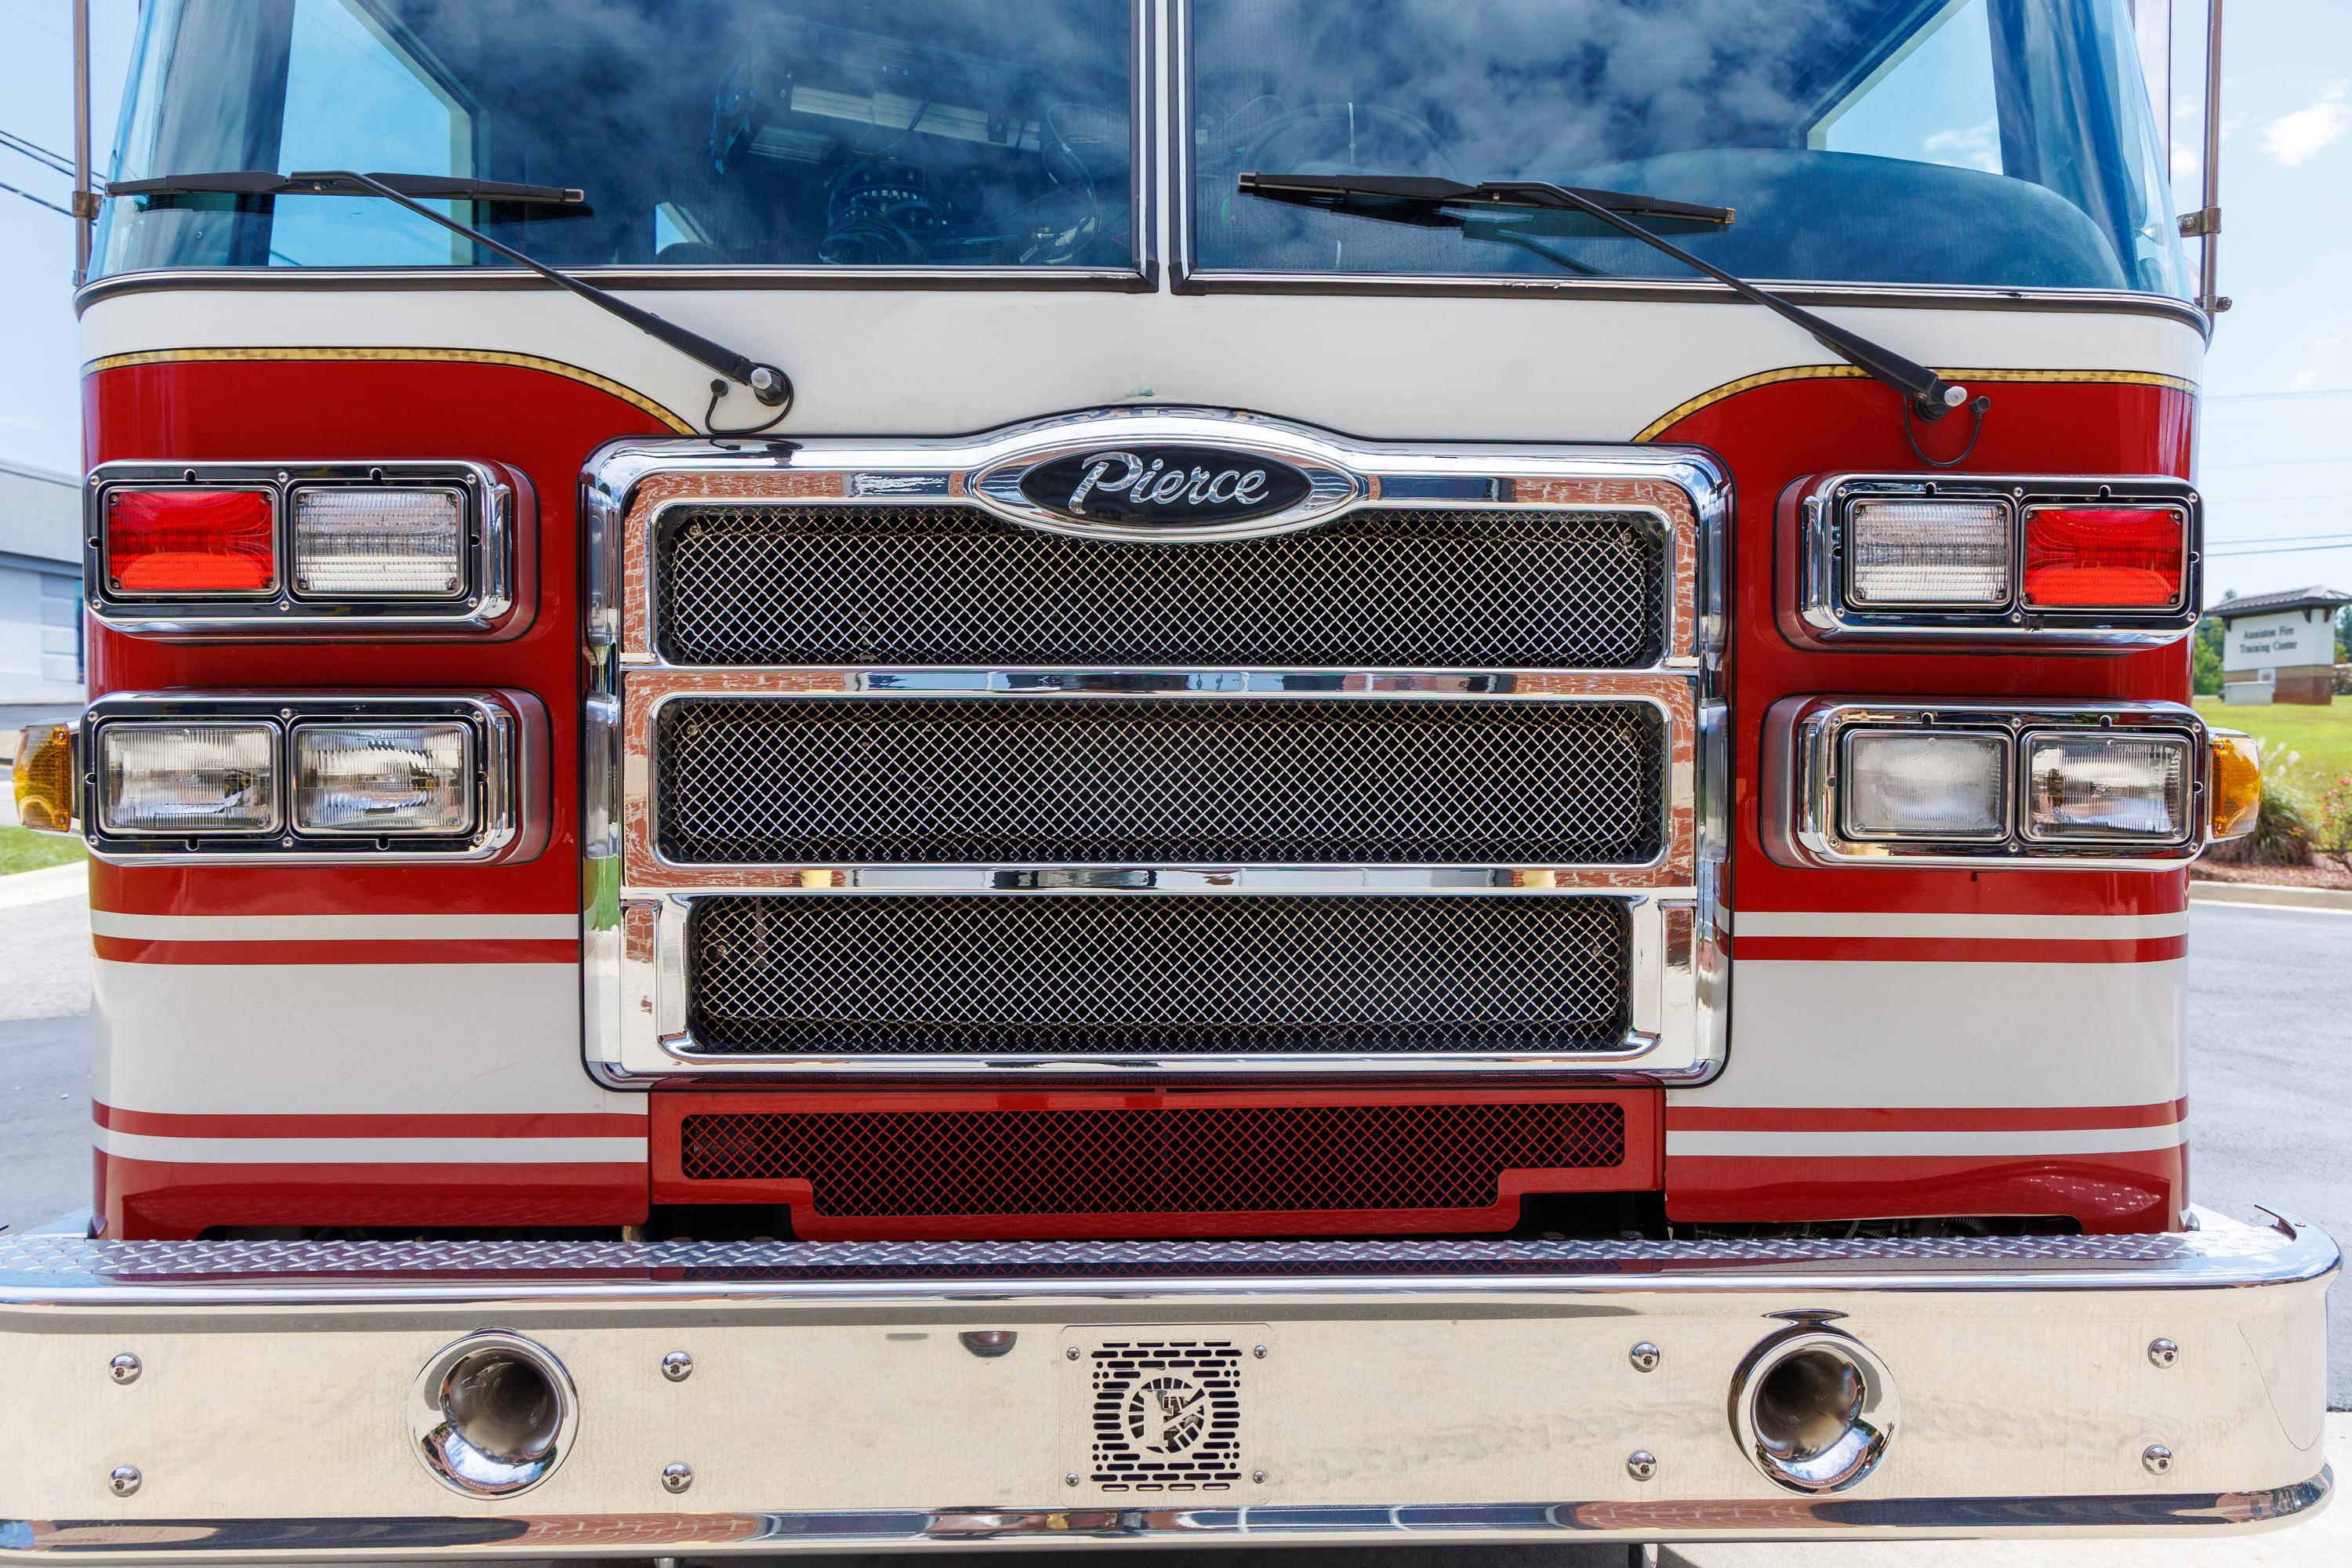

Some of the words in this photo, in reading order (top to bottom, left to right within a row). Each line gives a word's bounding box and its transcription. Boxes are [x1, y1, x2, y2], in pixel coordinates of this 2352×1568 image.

[1069, 452, 1269, 514] Pierce
[2279, 626, 2294, 636] Fire
[2240, 644, 2270, 653] Training
[2273, 641, 2298, 650] Center
